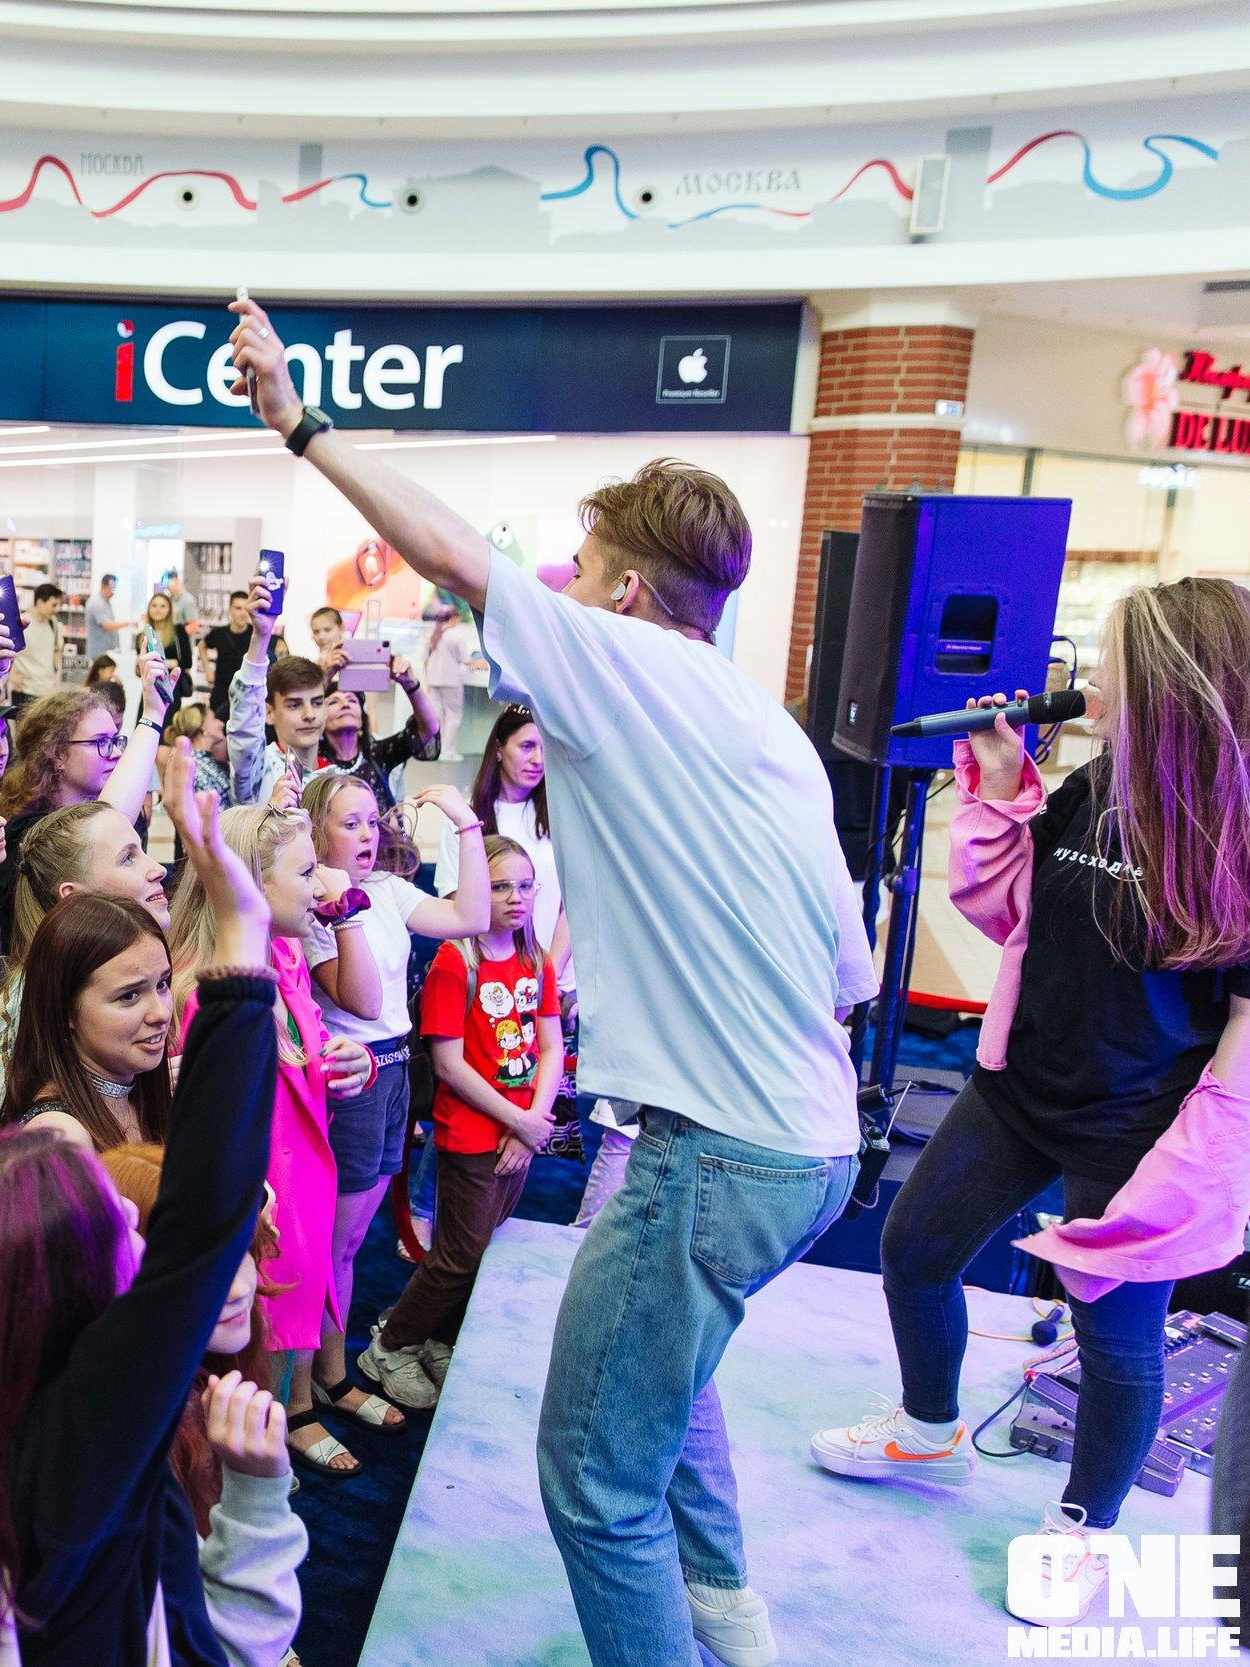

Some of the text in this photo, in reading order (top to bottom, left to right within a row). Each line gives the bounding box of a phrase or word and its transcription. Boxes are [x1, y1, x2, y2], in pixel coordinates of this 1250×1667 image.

[80, 152, 145, 176] МОСКВА
[675, 167, 803, 196] МОСКВА
[115, 319, 464, 410] iCenter
